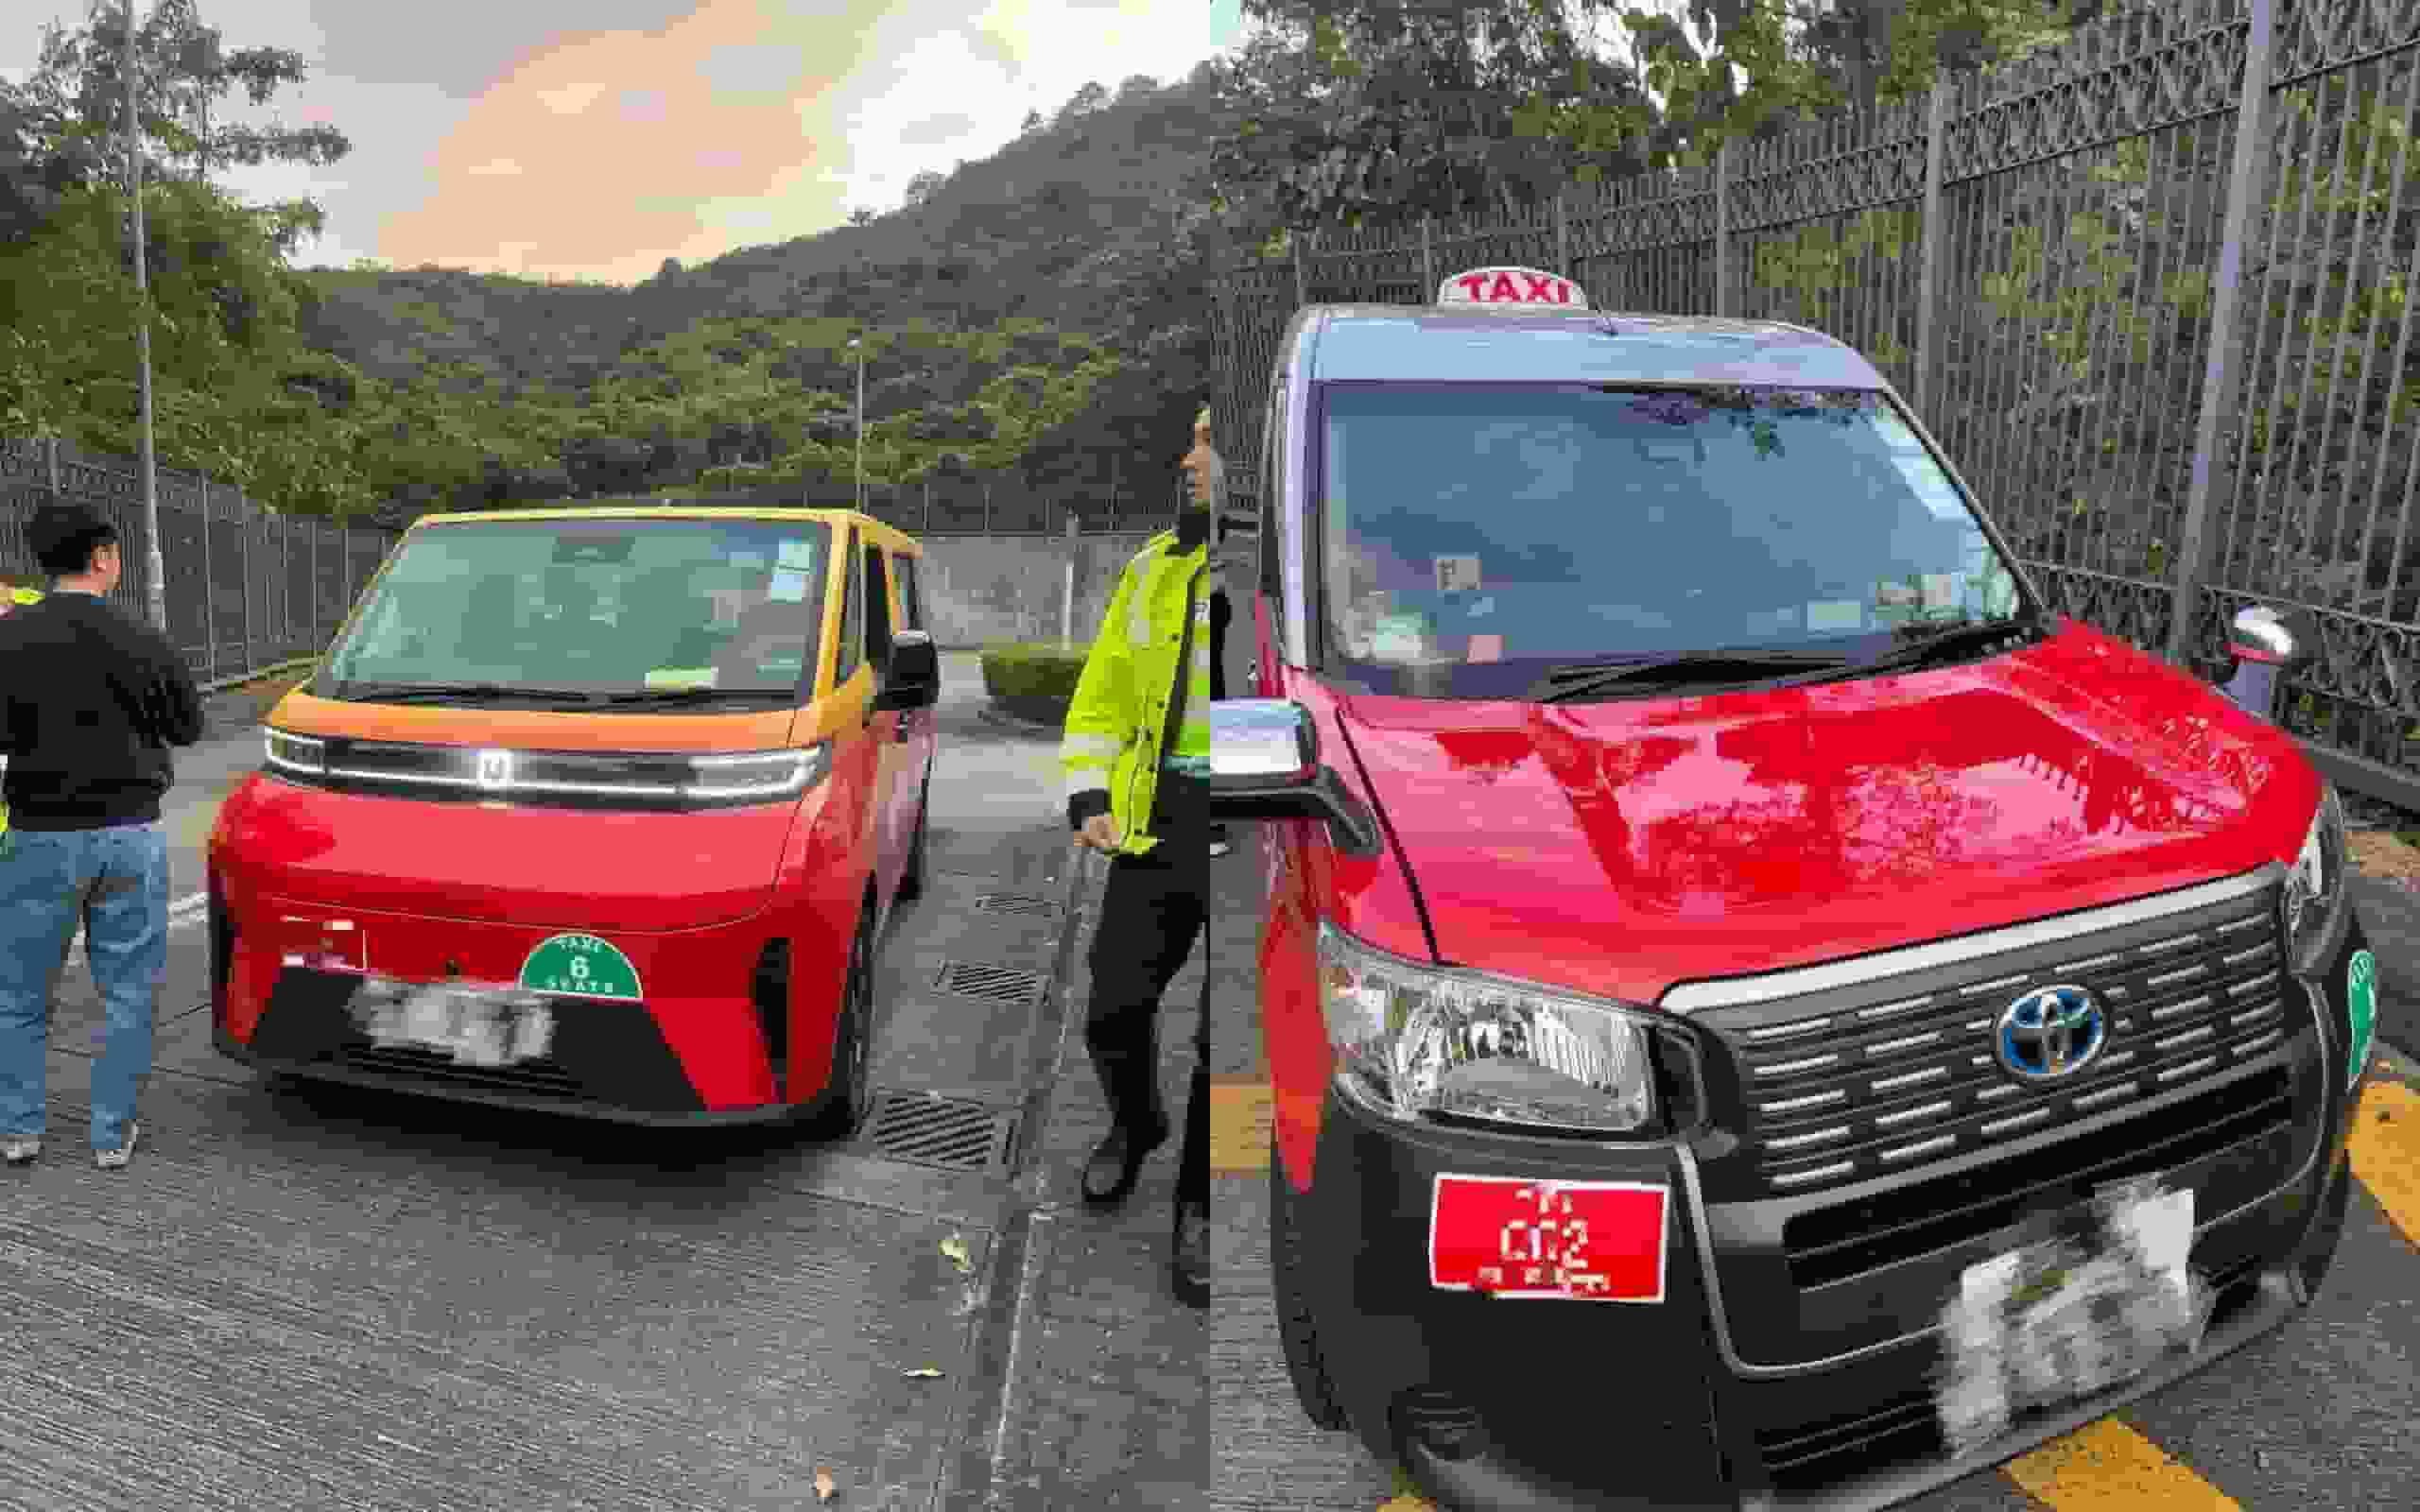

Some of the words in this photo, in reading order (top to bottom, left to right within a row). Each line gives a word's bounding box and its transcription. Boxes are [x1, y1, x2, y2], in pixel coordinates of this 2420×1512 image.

[1459, 273, 1573, 303] TAXI
[569, 954, 591, 980] 6
[545, 978, 614, 993] SAT
